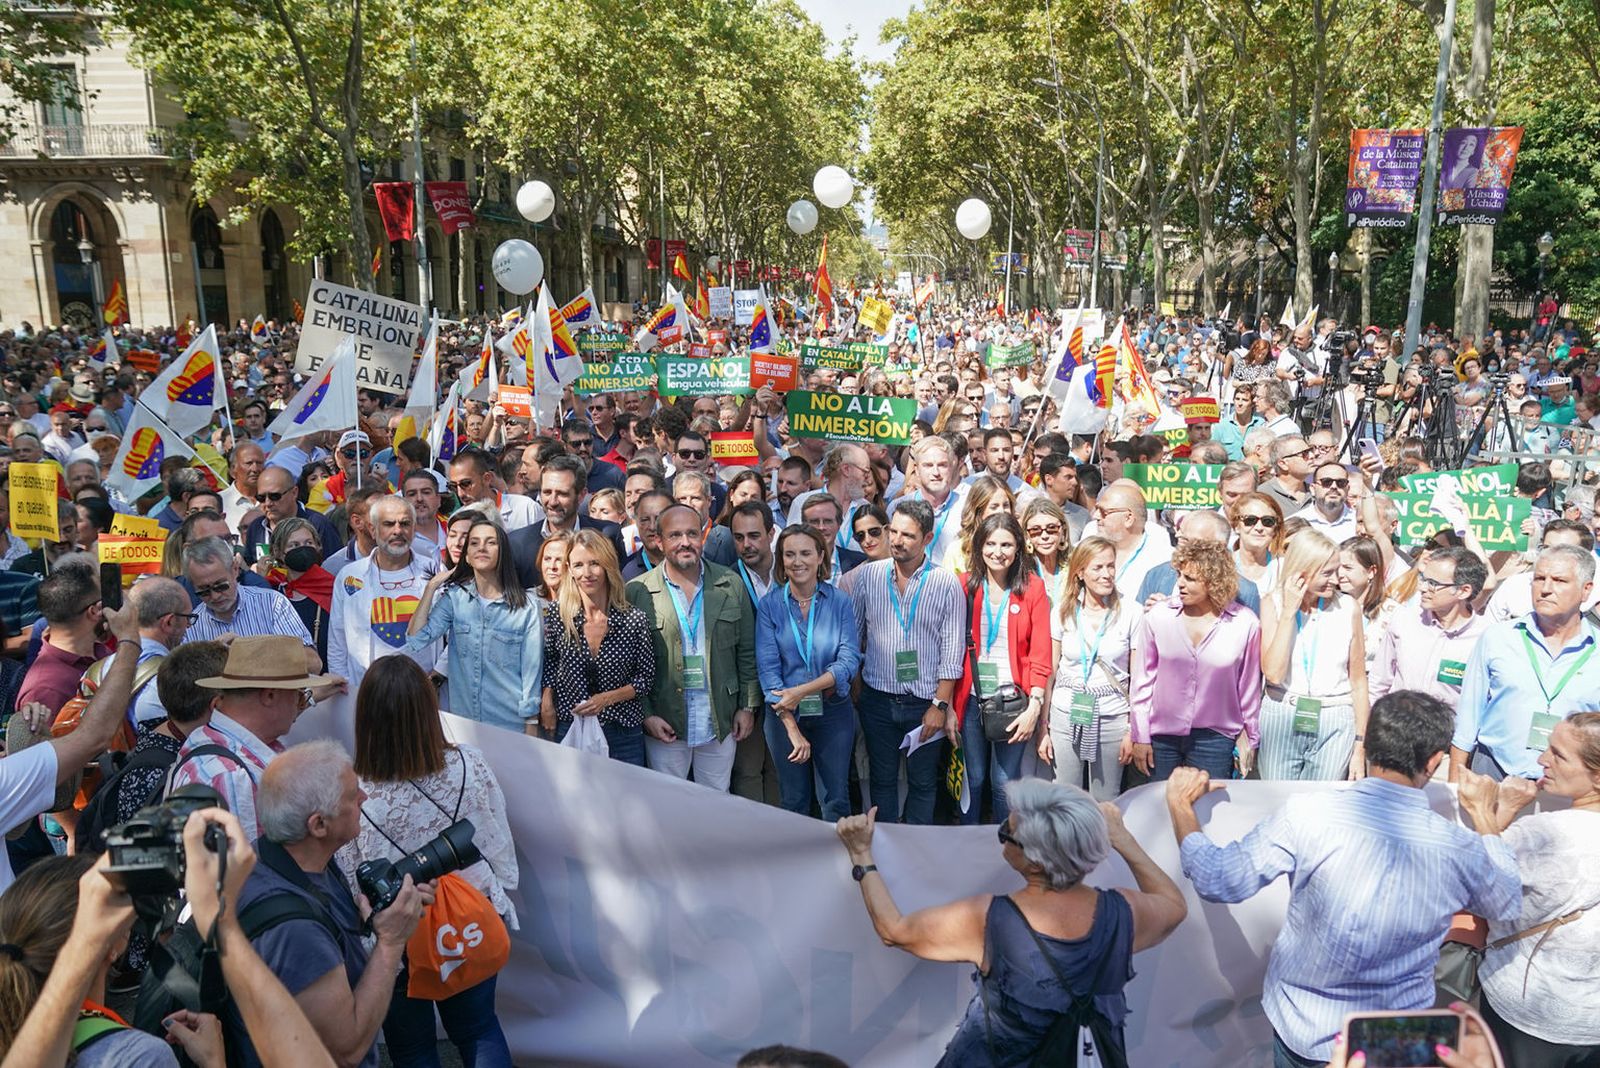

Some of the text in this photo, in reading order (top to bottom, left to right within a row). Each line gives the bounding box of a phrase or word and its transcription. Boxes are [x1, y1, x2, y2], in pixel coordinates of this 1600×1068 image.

[1396, 138, 1421, 149] Palau
[1363, 149, 1420, 159] de la Música
[1377, 159, 1418, 169] Catalana
[1467, 189, 1504, 199] Mitsuko
[1470, 199, 1502, 208] Uchida
[312, 288, 419, 327] CATALUÑA
[806, 347, 820, 357] EN
[820, 348, 855, 360] CATALÀ
[666, 358, 750, 378] ESPAÑOL,
[803, 357, 816, 366] EN
[308, 355, 405, 390] EAÑA
[588, 363, 644, 375] NO A LA
[666, 378, 750, 391] lengua vehicular
[810, 393, 894, 417] NO A LA
[793, 413, 908, 439] INMERSIÓN
[1164, 428, 1187, 440] NO
[714, 444, 725, 454] DE
[1147, 465, 1181, 482] NO
[1184, 465, 1202, 483] A
[1506, 504, 1513, 521] I
[104, 546, 117, 559] DE
[436, 922, 484, 957] Cs
